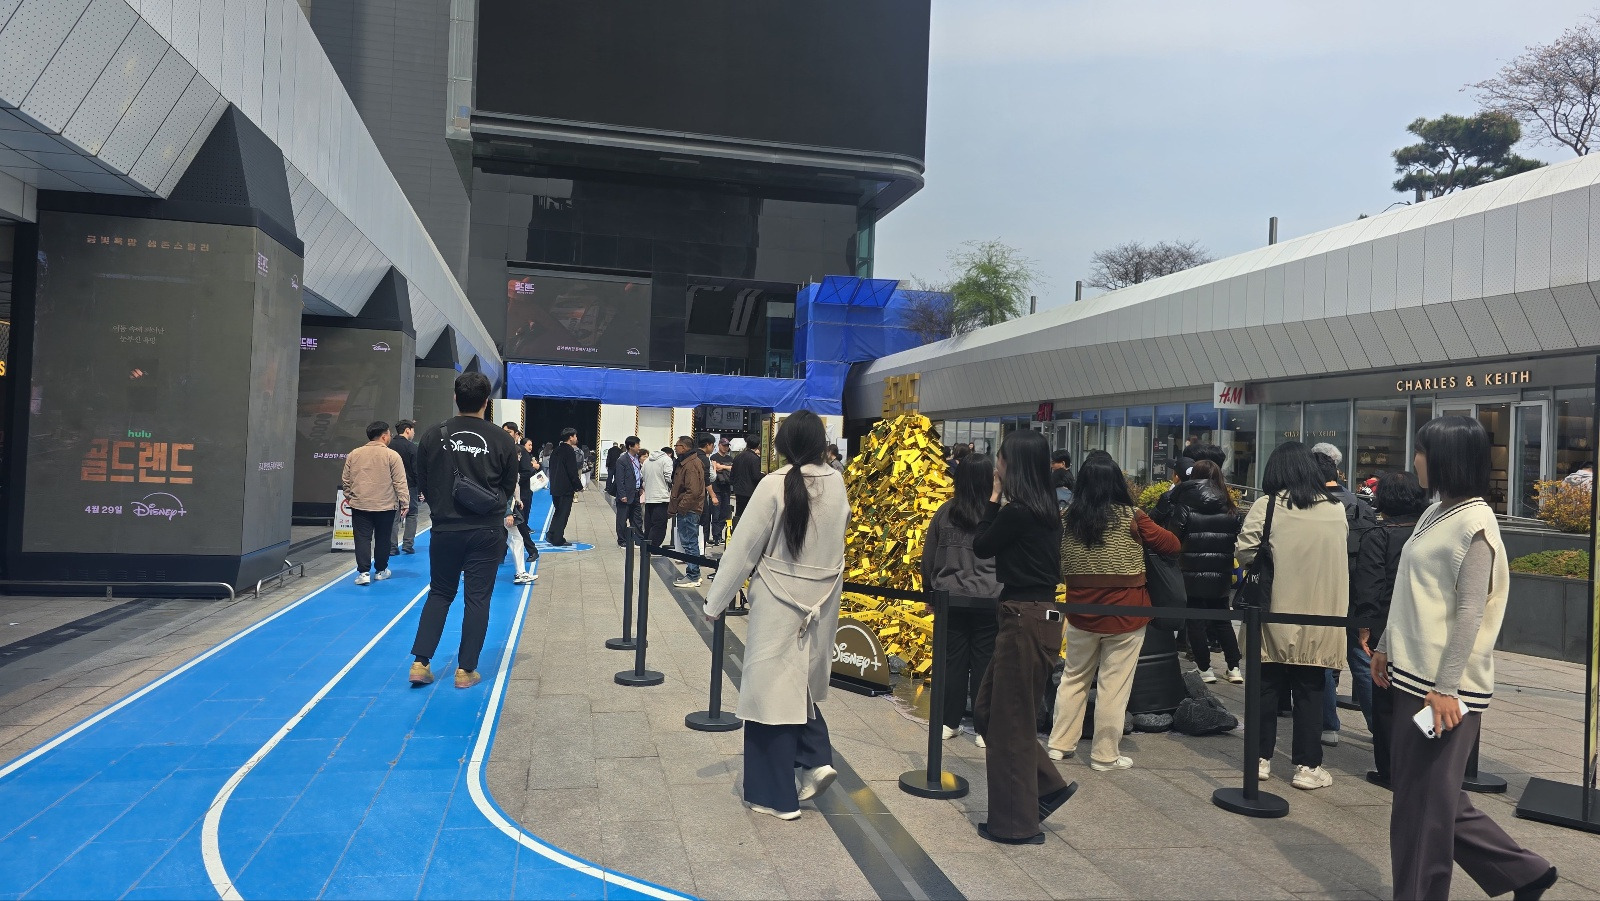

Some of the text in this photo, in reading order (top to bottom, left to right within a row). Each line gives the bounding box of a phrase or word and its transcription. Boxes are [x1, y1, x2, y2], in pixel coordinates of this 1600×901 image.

[300, 337, 318, 347] 드랜드
[1396, 370, 1530, 392] CHARLES & KEITH
[1219, 386, 1244, 405] H&M
[127, 429, 152, 438] hulu
[81, 439, 195, 484] 골드랜드
[84, 492, 187, 521] 4월 29일 Disney+
